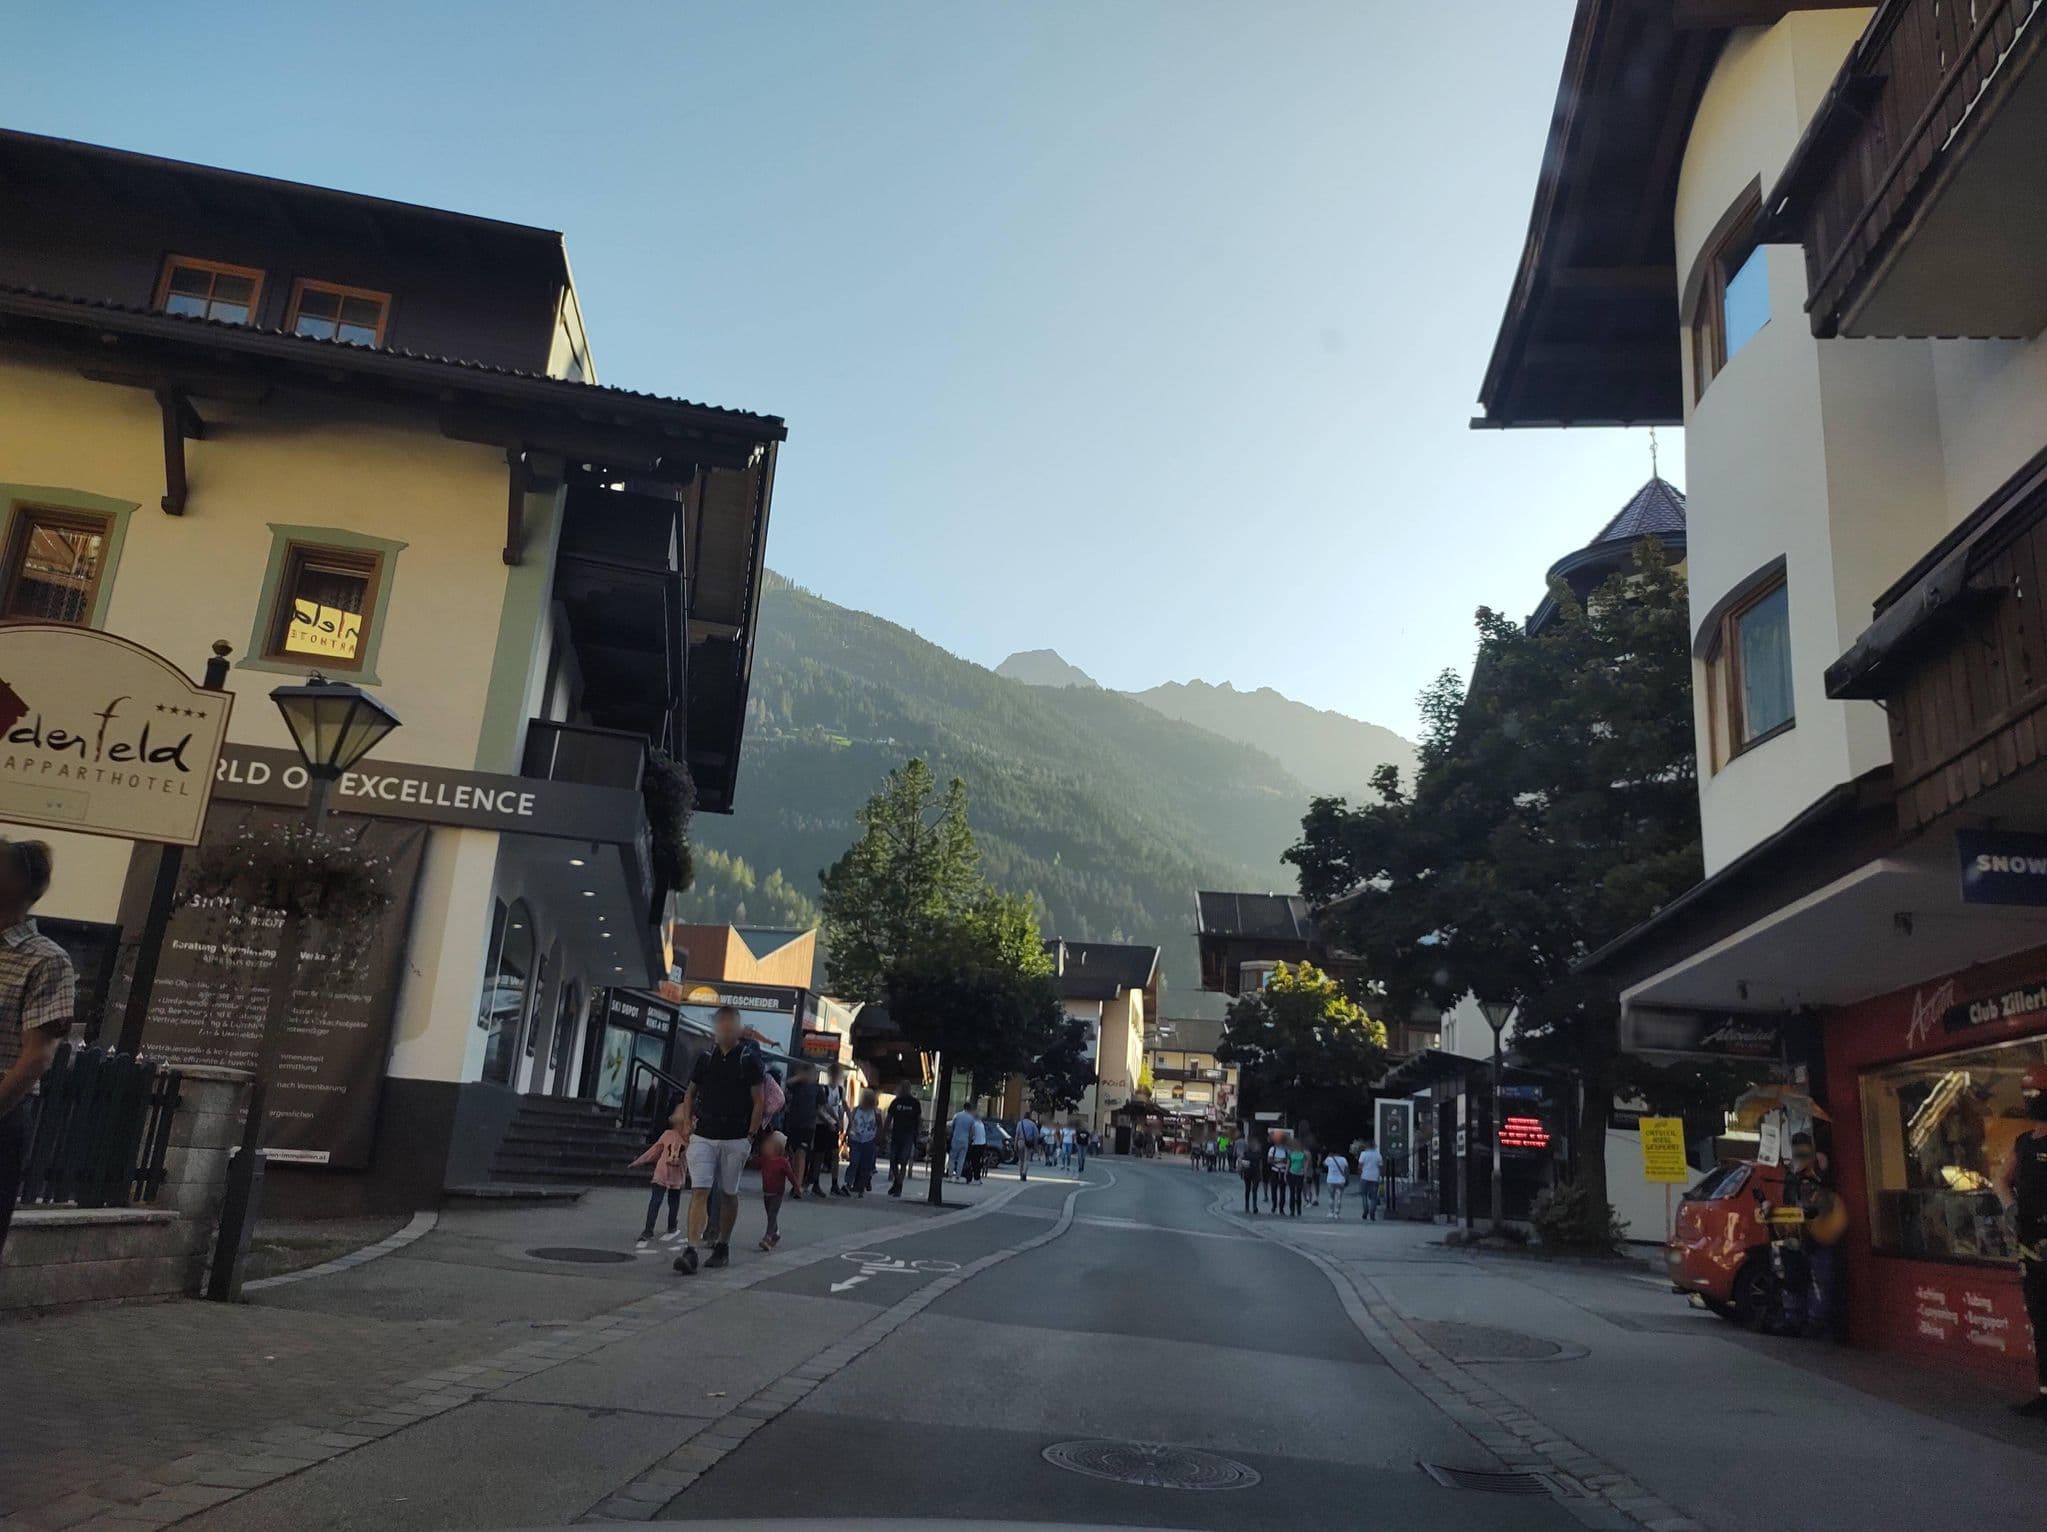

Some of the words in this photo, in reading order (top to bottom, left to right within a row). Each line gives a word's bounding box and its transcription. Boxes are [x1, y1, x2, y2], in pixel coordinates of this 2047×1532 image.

[3, 755, 190, 797] APPARTHOTEL
[282, 765, 309, 790] O
[338, 773, 536, 816] EXCELLENCE
[611, 999, 622, 1013] SKI
[621, 1003, 640, 1018] DEPOT
[720, 994, 780, 1009] WEGSCHEIDER
[1969, 998, 1999, 1025] Club
